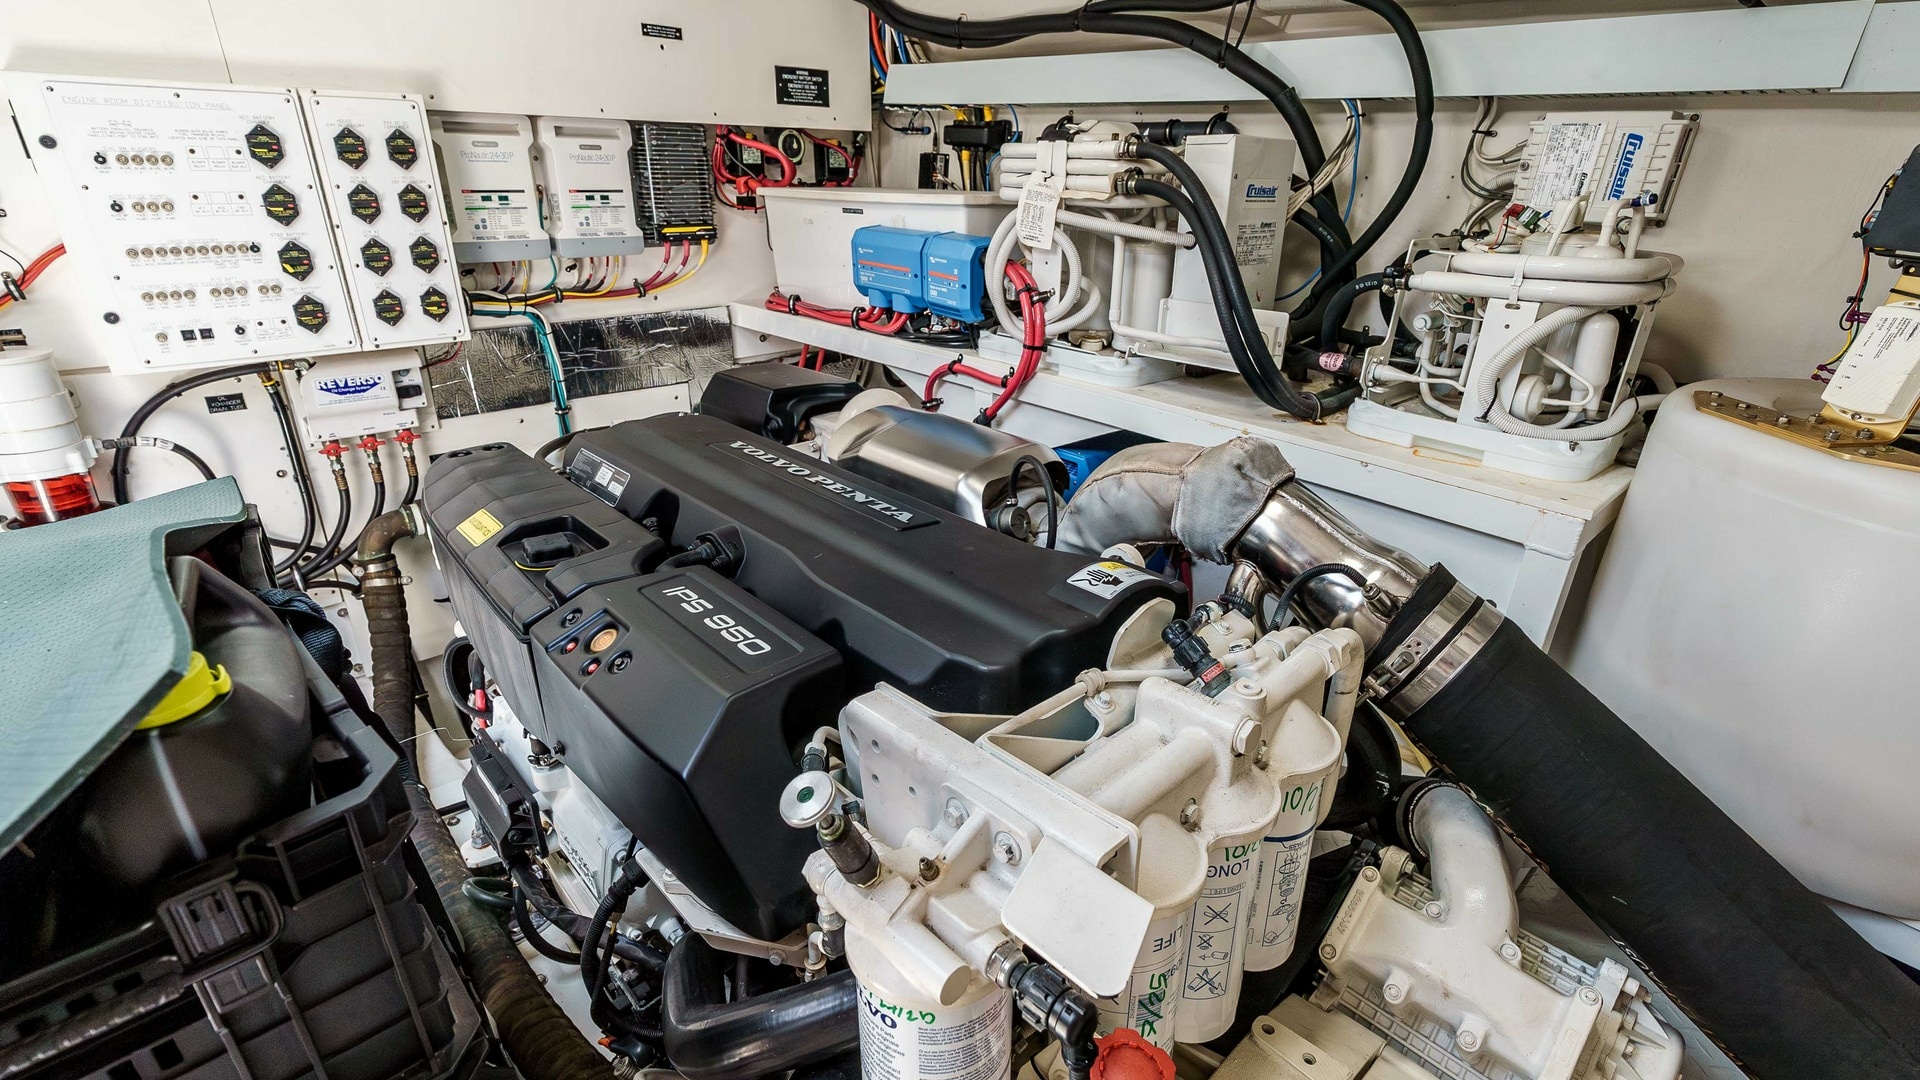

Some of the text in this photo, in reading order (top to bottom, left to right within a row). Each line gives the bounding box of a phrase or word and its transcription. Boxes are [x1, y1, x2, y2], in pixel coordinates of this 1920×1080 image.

[61, 95, 231, 110] ENGINE ROOM DISTRIBUTION PANEL
[460, 151, 489, 160] ProNautic
[569, 153, 594, 161] ProNautic
[1608, 132, 1644, 201] Cruisair
[1246, 184, 1279, 199] Cruisair
[315, 373, 385, 390] REVERSO
[730, 440, 915, 524] VOLVO PENTA
[662, 586, 772, 656] IPS 950
[1207, 858, 1250, 879] LONG
[1152, 924, 1184, 953] LIFE
